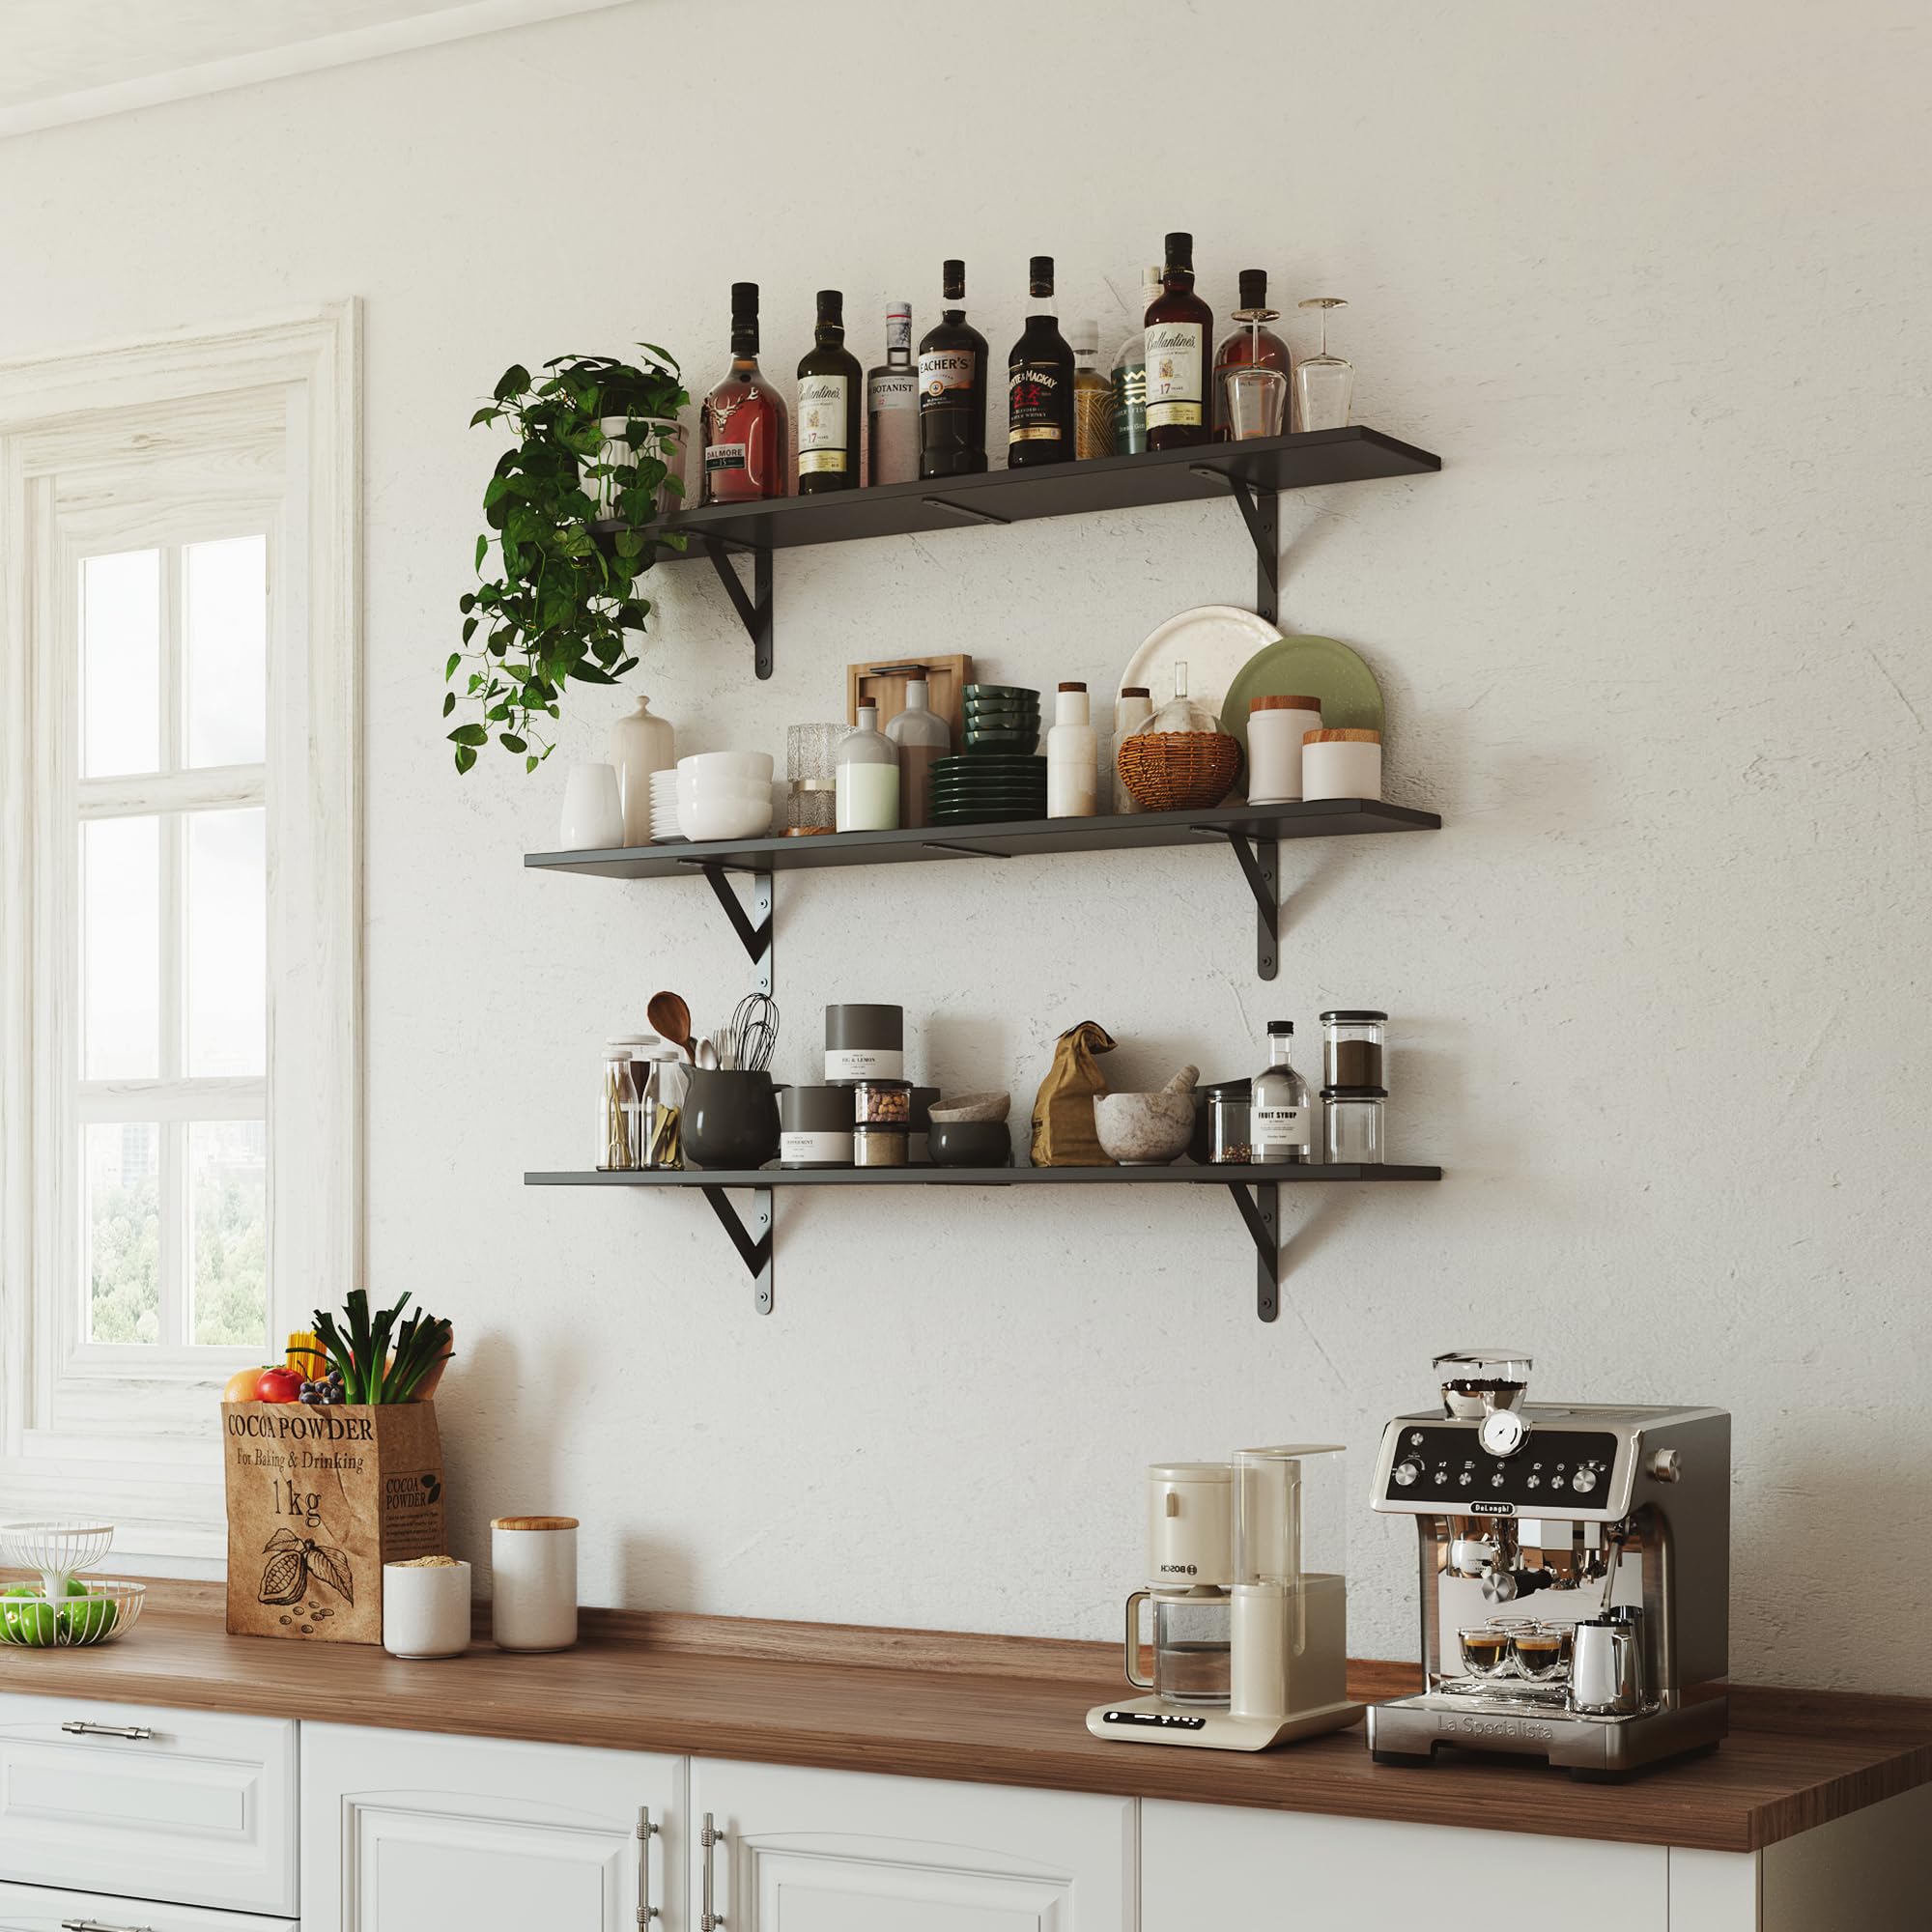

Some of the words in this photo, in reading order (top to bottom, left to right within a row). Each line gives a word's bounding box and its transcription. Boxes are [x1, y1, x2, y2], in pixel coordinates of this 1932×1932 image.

[1147, 330, 1196, 354] Ballantine's
[920, 356, 969, 373] EACHER'S
[1025, 370, 1058, 388] MACKAY
[872, 384, 914, 394] BOTANIST
[1160, 383, 1171, 395] 17
[707, 448, 743, 459] DALMORE
[1258, 1111, 1274, 1120] FRUIT
[1276, 1111, 1296, 1120] SYRUP
[228, 1413, 275, 1438] COCOA
[278, 1417, 374, 1440] POWDER
[237, 1448, 251, 1465] For
[255, 1448, 285, 1472] Baking
[288, 1451, 298, 1468] &
[301, 1451, 363, 1474] Drinking
[386, 1477, 418, 1493] COCOA
[386, 1492, 426, 1510] POWDER
[1437, 1715, 1457, 1732] La
[1462, 1716, 1553, 1739] Specialista
